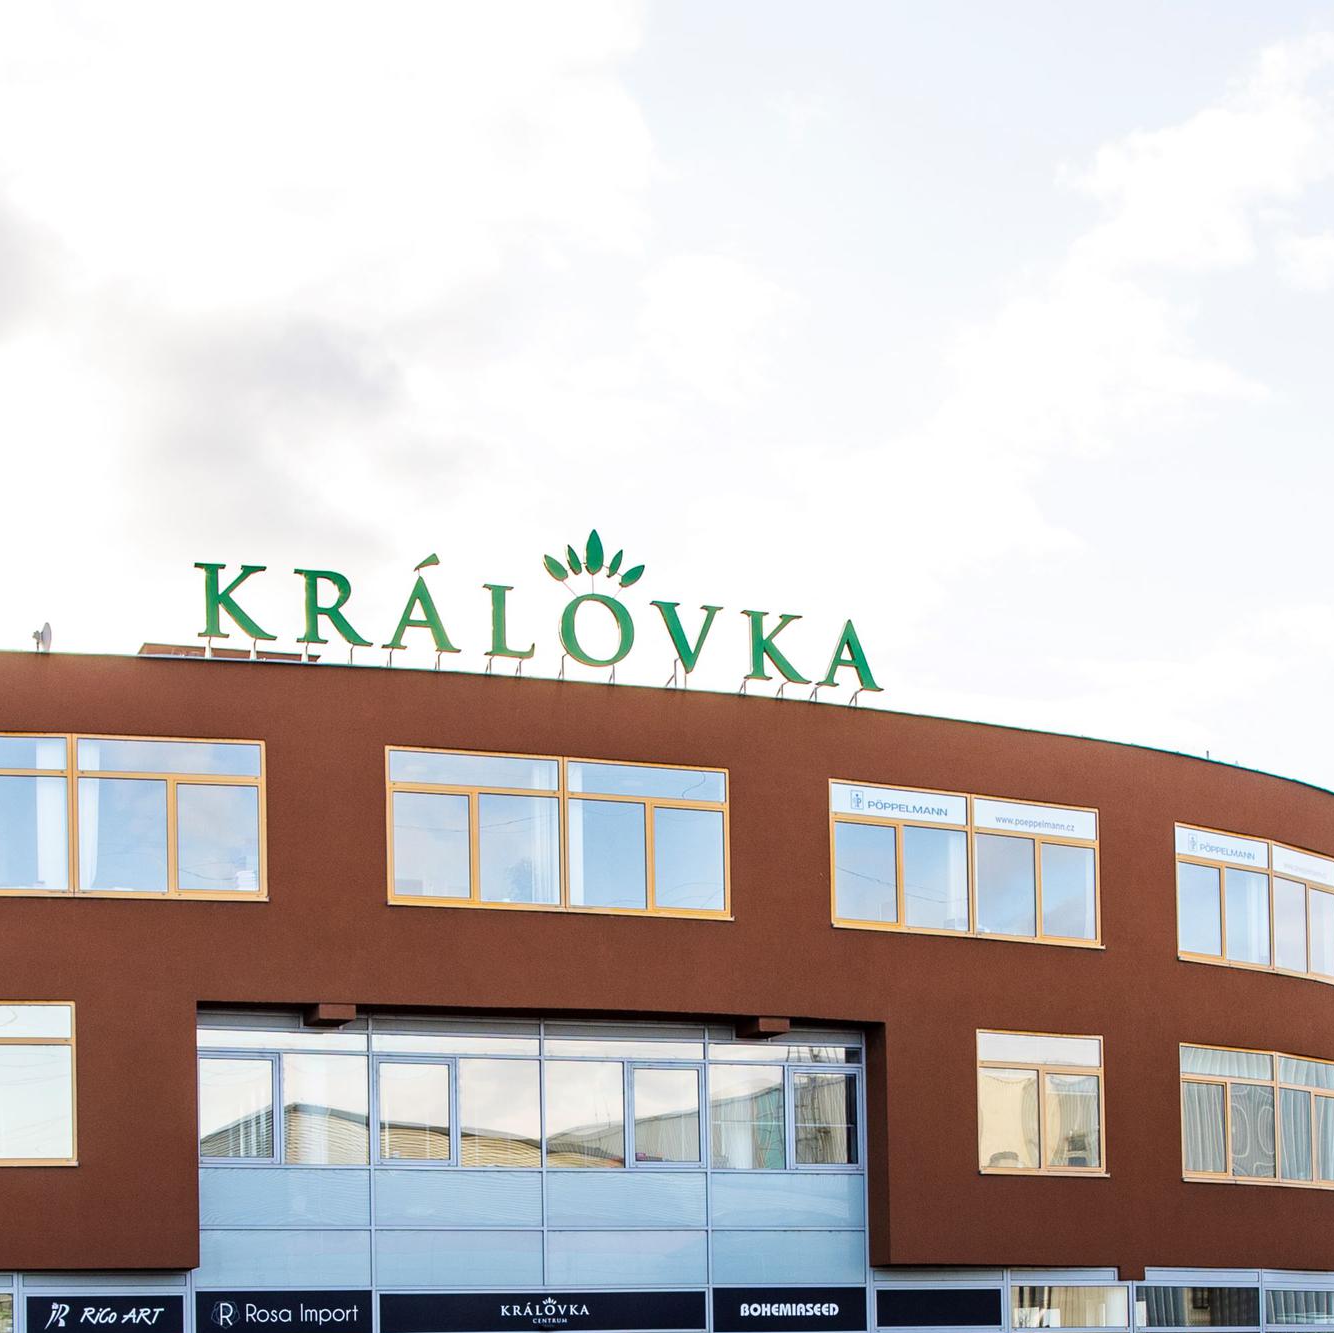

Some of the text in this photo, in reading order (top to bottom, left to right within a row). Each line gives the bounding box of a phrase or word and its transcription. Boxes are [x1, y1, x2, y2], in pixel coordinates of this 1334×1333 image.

[193, 552, 885, 692] KRÁLOVKA
[867, 800, 948, 816] PÖPPELMANN
[995, 816, 1075, 832] www.poeppelmann.cz
[1200, 842, 1255, 861] PÖPPELMANN
[121, 1308, 164, 1325] ART
[246, 1305, 292, 1322] Rosa
[300, 1304, 358, 1325] Import
[500, 1302, 589, 1316] KRÁLOVKA
[740, 1303, 839, 1316] BOHEMIASEED
